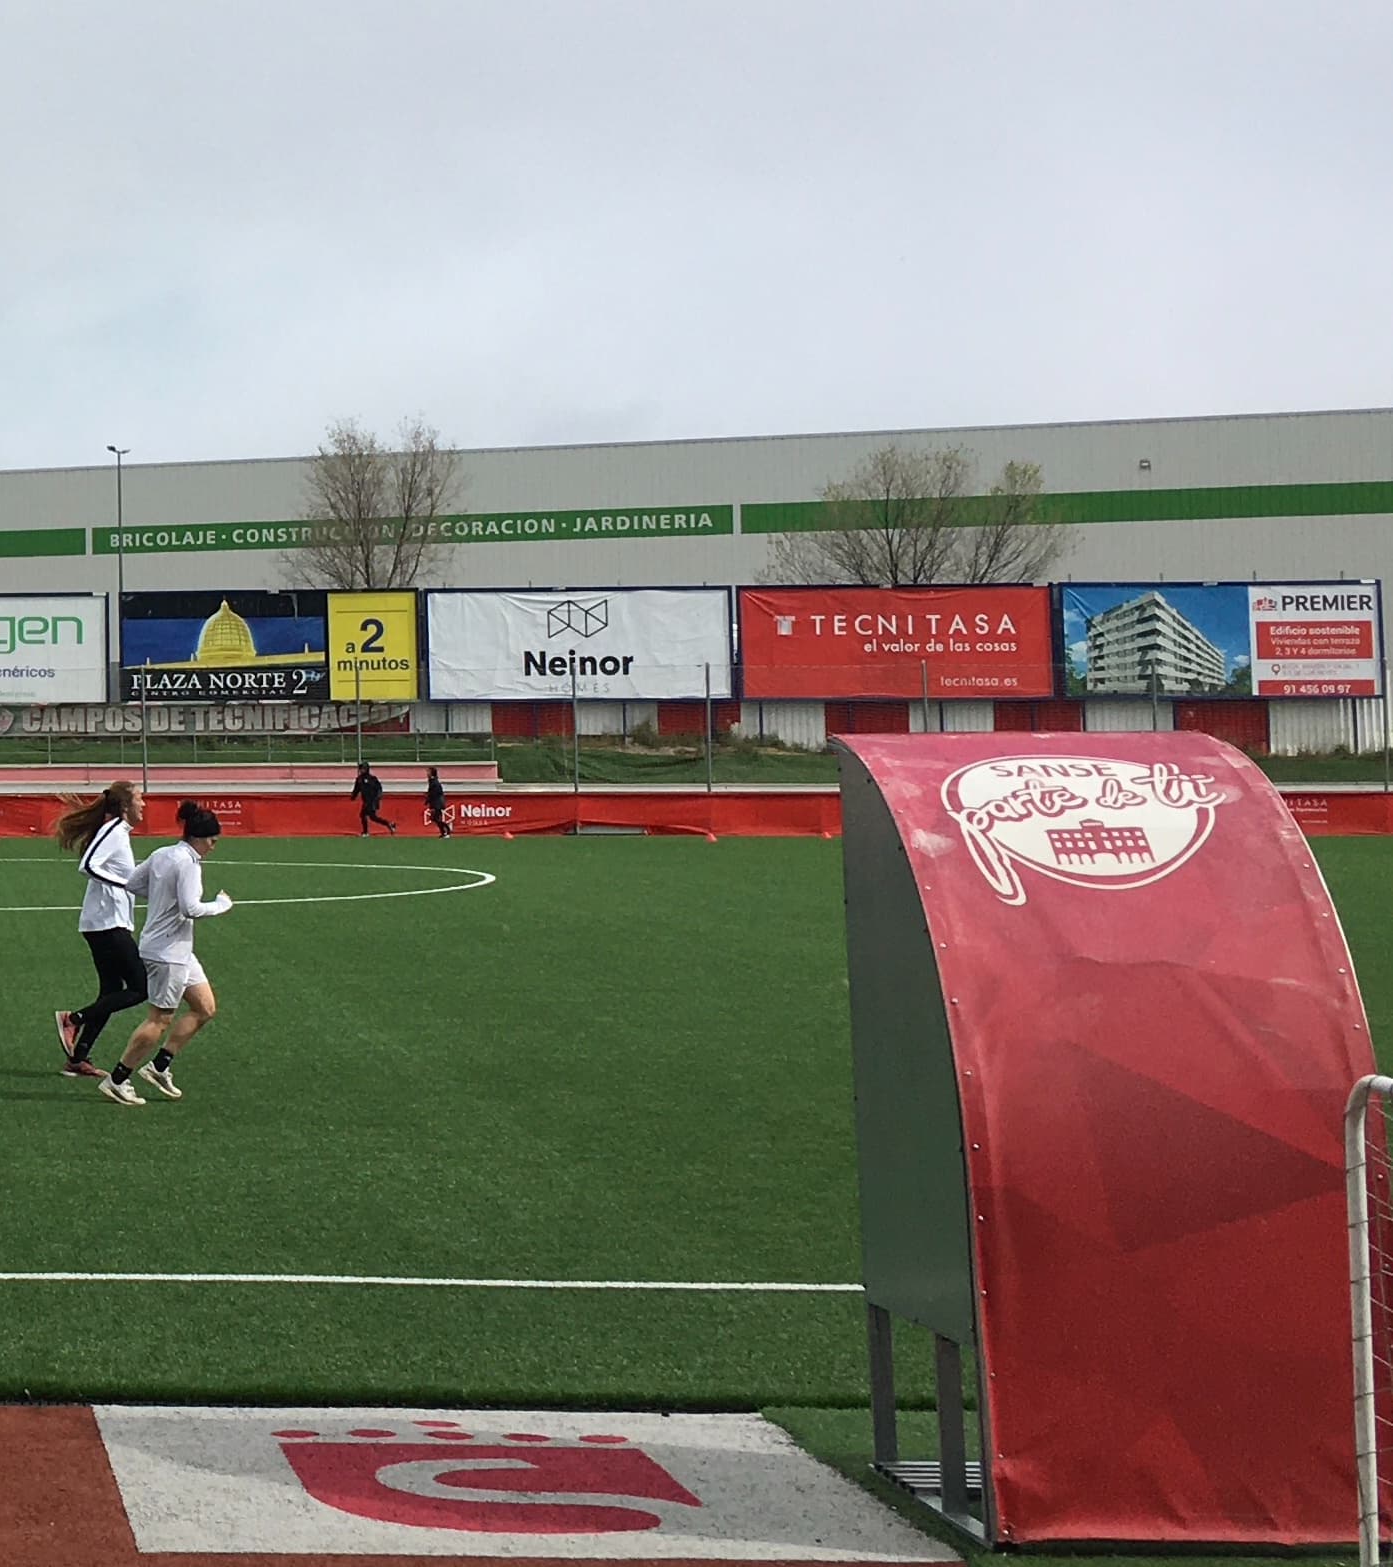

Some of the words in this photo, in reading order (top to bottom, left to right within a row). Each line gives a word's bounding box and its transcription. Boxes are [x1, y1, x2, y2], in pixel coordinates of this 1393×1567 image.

[110, 530, 216, 548] BRICOLAJE
[411, 518, 556, 537] DECORACION
[572, 513, 713, 533] JARDINERIA
[1281, 594, 1373, 611] PREMIER
[810, 614, 1016, 635] TECNITASA
[1270, 625, 1307, 635] Edificio
[1309, 625, 1360, 635] sostenible
[345, 641, 356, 653] a
[359, 619, 385, 653] 2
[1271, 637, 1312, 645] Viviendas
[1331, 637, 1360, 645] terraza
[864, 639, 878, 652] el
[882, 639, 920, 652] valor
[925, 639, 944, 652] de
[949, 639, 970, 652] las
[975, 641, 1017, 652] cosas
[337, 657, 410, 671] minutos
[524, 650, 634, 676] Neinor
[131, 673, 202, 689] PLAZA
[209, 672, 286, 688] NORTE
[292, 668, 307, 694] 2
[549, 682, 611, 693] HOMES
[940, 676, 1018, 686] tecnitasa.es
[1283, 685, 1296, 693] 91
[1300, 684, 1320, 693] 456
[1338, 684, 1351, 693] 97
[22, 704, 143, 732] CAMPOS
[150, 704, 188, 732] DE
[989, 764, 1121, 778] SANSE
[460, 804, 512, 818] Neinor
[947, 778, 1088, 906] parte
[1097, 779, 1147, 808] de
